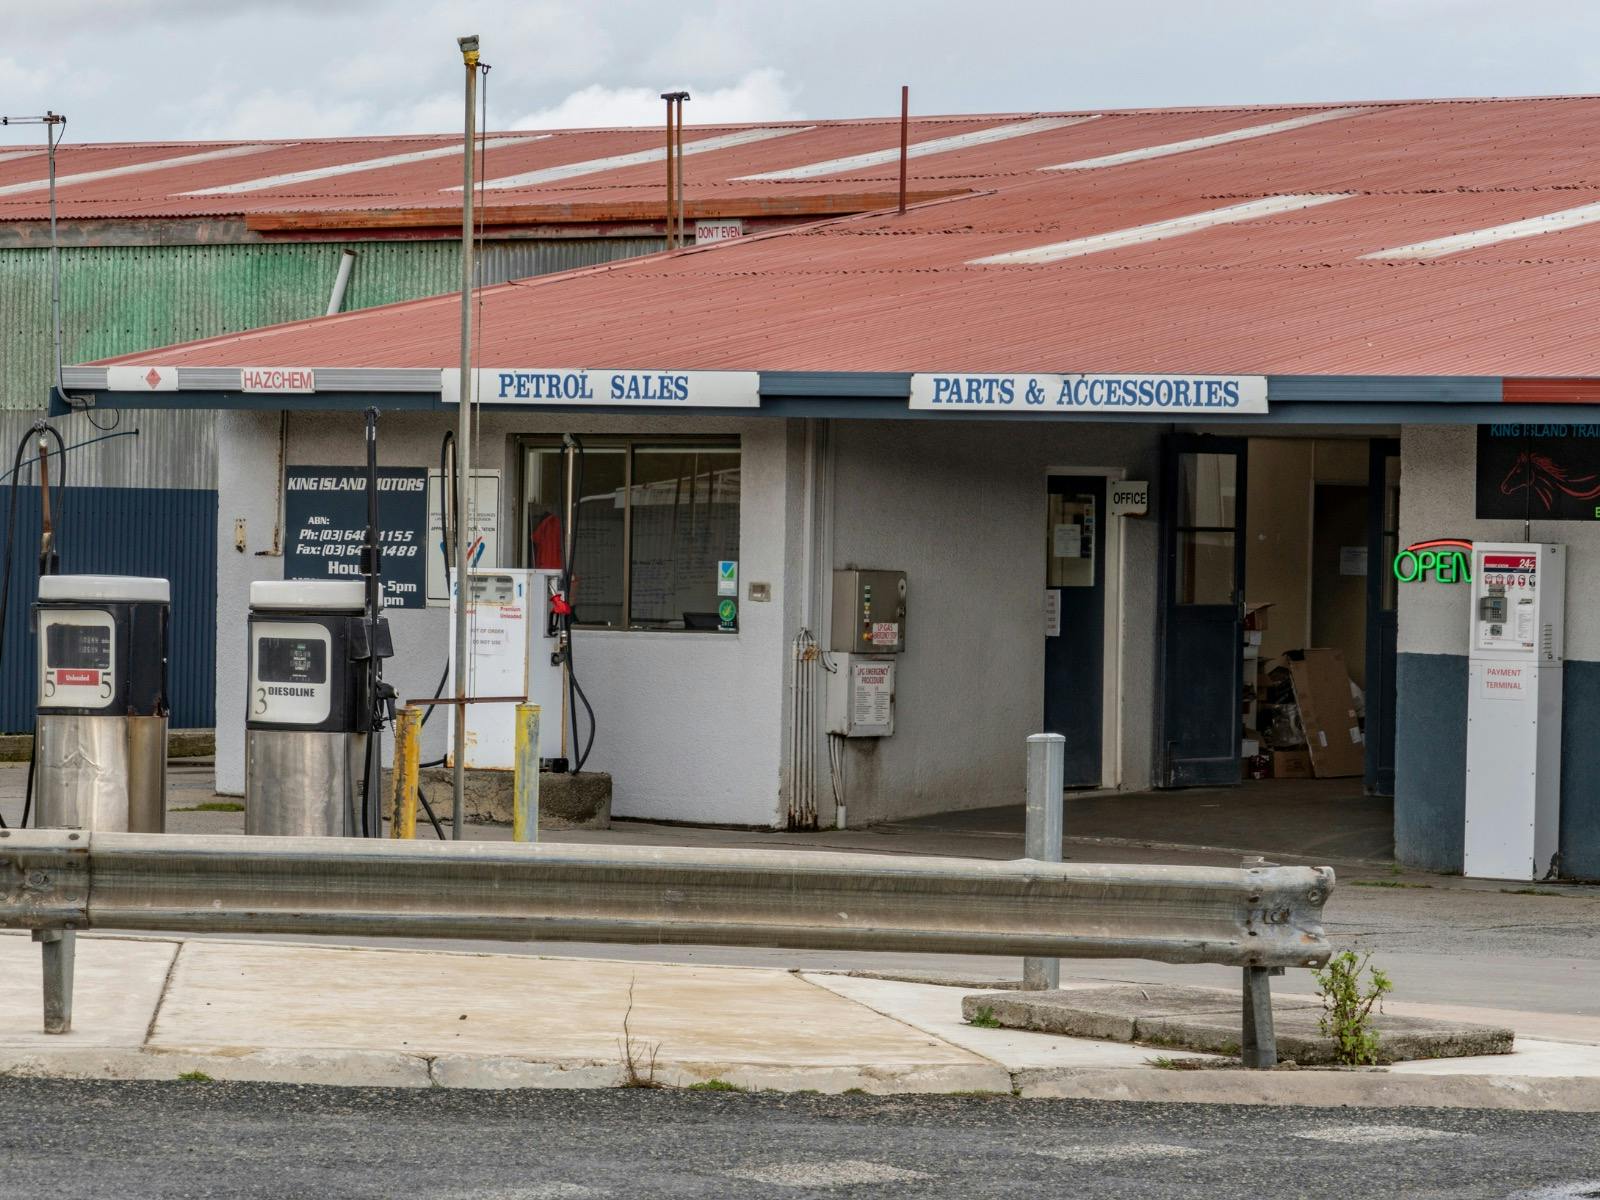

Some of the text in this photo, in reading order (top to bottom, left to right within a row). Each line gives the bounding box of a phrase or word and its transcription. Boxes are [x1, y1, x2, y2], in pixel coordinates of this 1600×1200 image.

[698, 226, 740, 239] DON'T EVEN
[244, 371, 312, 389] HAZCHEM
[498, 373, 689, 401] PETROL SALES
[932, 377, 1240, 408] PARTS & ACCESSORIES
[1490, 423, 1521, 437] KING
[287, 477, 320, 491] KING
[319, 477, 367, 491] ISLAND
[1113, 492, 1147, 505] OFFICE
[308, 516, 330, 525] ABN:
[299, 529, 318, 541] Ph:
[319, 529, 344, 542] (03)
[380, 530, 414, 541] 1155
[296, 544, 321, 555] Fax:
[321, 544, 346, 557] (03)
[382, 546, 418, 557] 1488
[1393, 551, 1472, 582] OPEN
[1487, 668, 1521, 677] PAYMENT
[45, 672, 112, 699] 5 Unleaded 5
[1486, 681, 1522, 690] TERMINAL
[255, 686, 315, 715] 3 DIESOLINE
